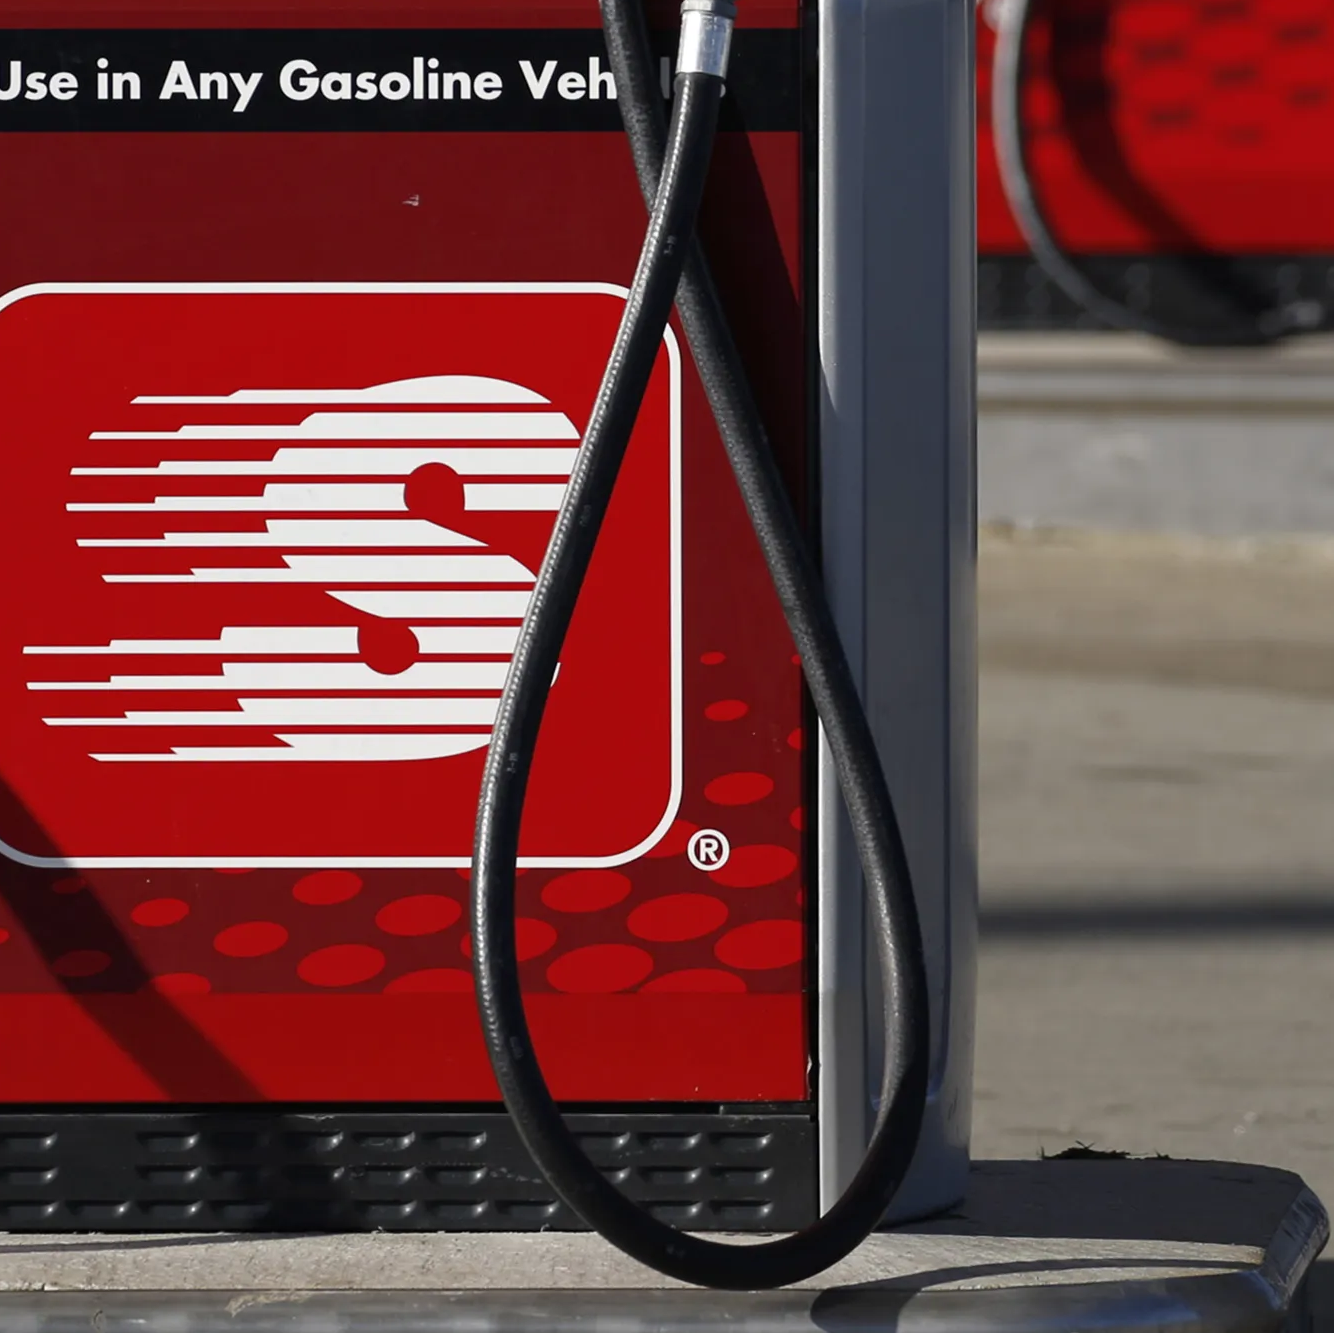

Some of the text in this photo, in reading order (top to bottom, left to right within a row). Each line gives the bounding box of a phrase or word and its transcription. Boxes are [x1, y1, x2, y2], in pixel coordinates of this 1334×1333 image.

[96, 60, 141, 100] in
[160, 62, 263, 112] Any
[279, 60, 503, 102] Gasoline
